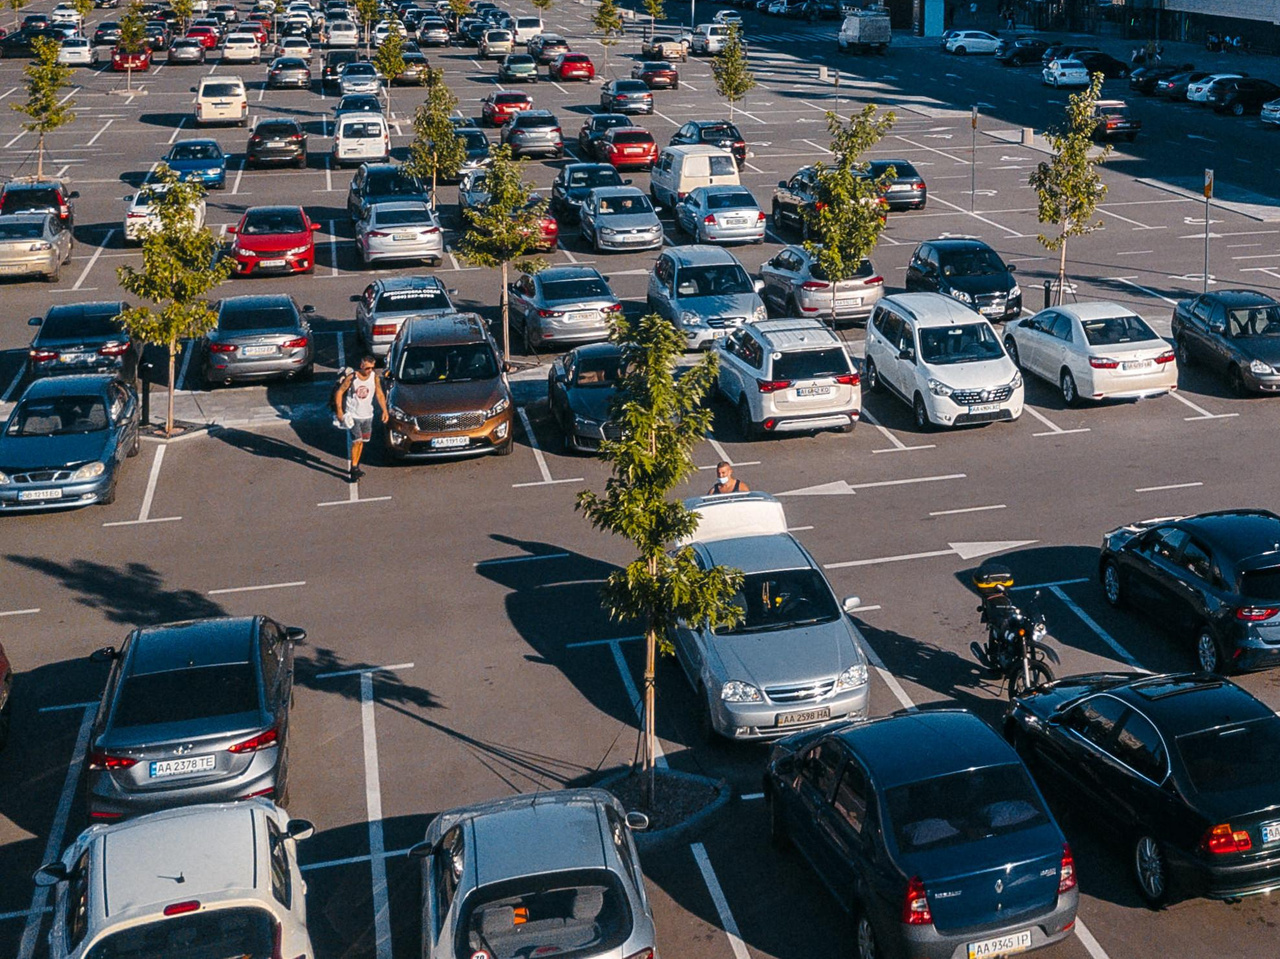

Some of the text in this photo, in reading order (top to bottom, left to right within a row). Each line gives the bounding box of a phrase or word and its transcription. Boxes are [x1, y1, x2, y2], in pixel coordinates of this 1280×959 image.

[783, 710, 828, 724] AA 2598 HA
[158, 757, 214, 773] AA 2378 TE
[1268, 827, 1280, 838] AA
[976, 934, 1028, 955] AA 9345 IP
